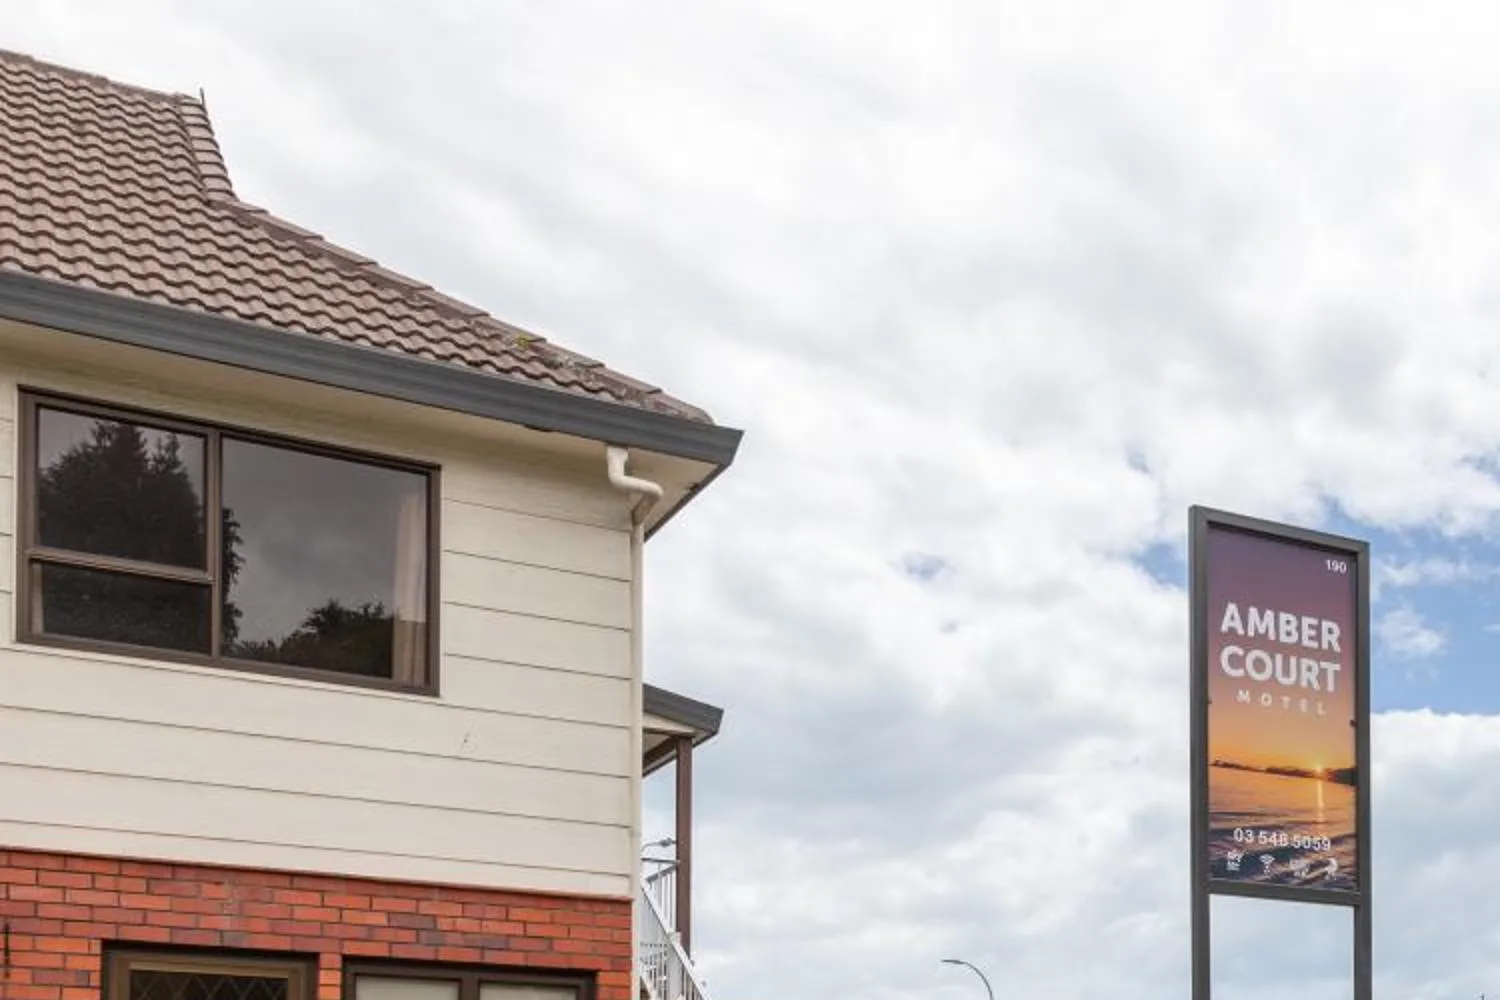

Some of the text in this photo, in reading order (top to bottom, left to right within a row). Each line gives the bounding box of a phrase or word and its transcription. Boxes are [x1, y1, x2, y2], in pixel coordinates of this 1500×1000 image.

[1325, 559, 1347, 574] 190
[1220, 601, 1341, 653] AMBER
[1220, 645, 1341, 692] COURT
[1236, 687, 1326, 716] MOTEL
[1233, 827, 1254, 843] 03
[1291, 834, 1331, 851] 5059
